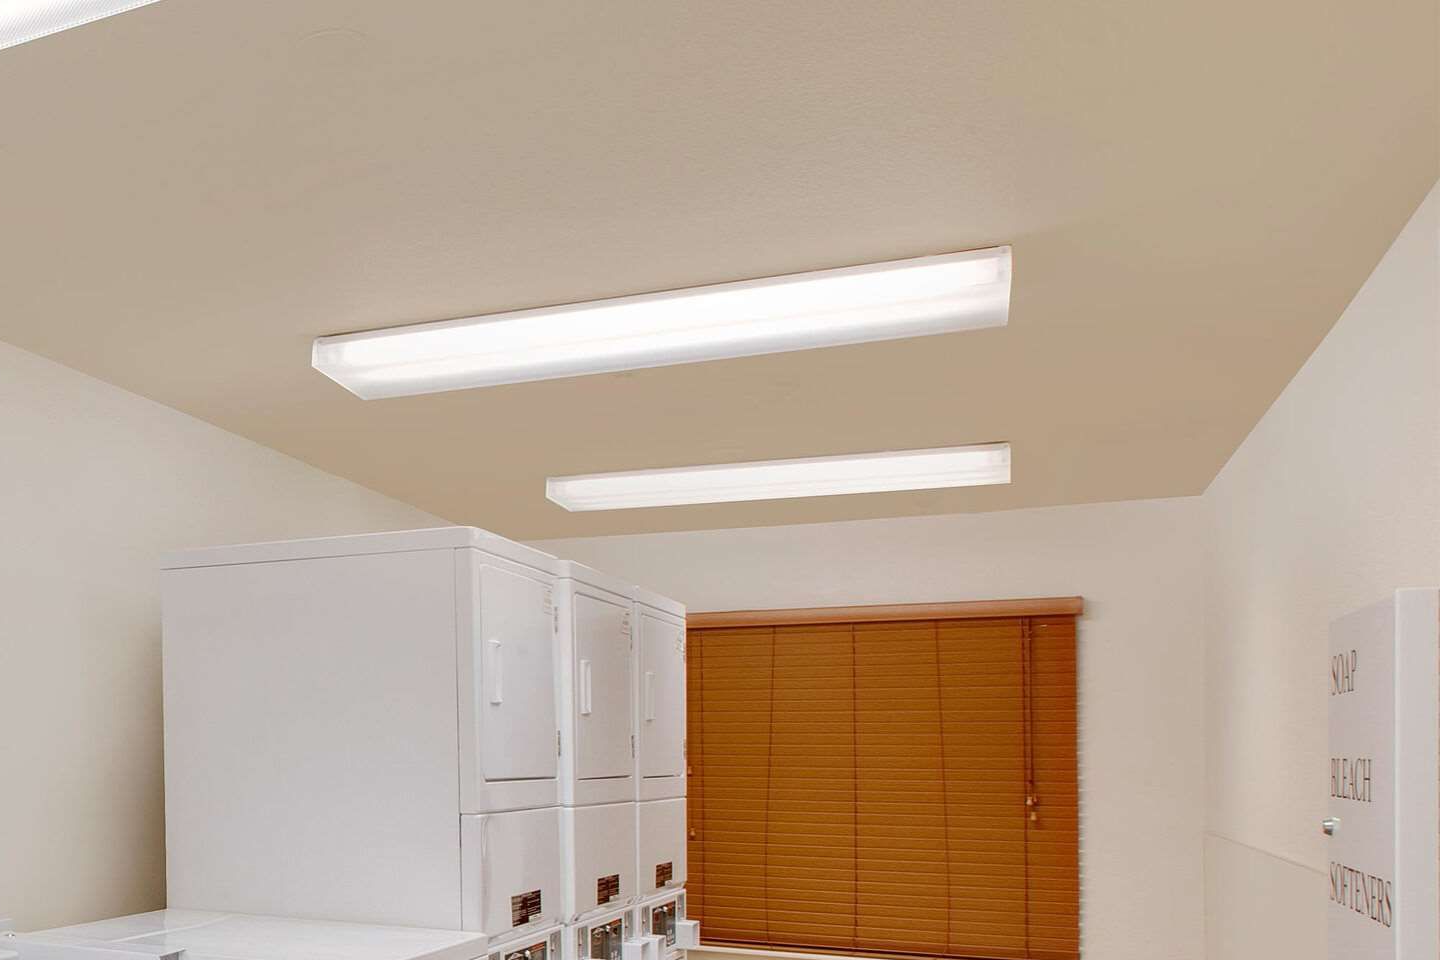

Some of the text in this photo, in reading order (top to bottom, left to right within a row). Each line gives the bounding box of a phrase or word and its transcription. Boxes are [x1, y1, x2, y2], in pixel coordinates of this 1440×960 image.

[1331, 649, 1357, 696] SOAP
[1331, 757, 1372, 803] BLEACH
[1329, 860, 1393, 929] SOFTENERS
